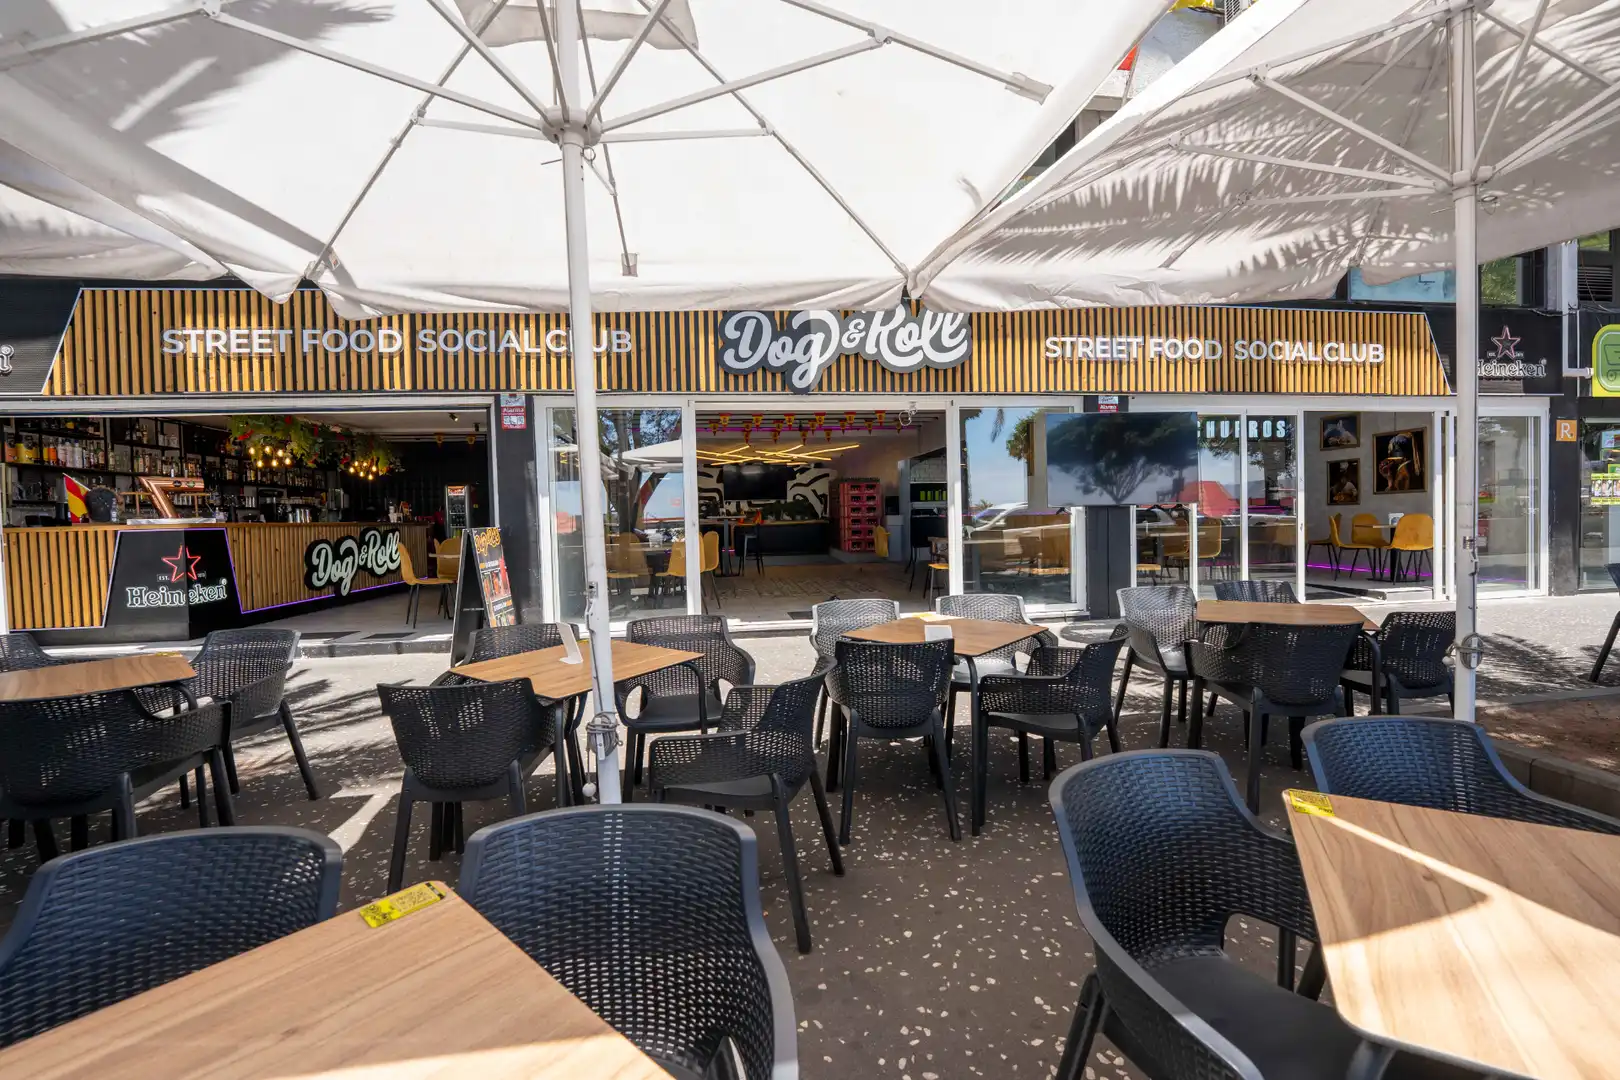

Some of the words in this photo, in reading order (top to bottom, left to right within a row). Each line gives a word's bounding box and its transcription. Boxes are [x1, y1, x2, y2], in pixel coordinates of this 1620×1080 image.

[162, 329, 293, 354] STREET
[302, 329, 403, 354] FOOD
[545, 329, 632, 353] CUB
[1045, 336, 1144, 361] STREET
[1149, 338, 1223, 361] FOOD
[126, 583, 228, 608] Heineken
